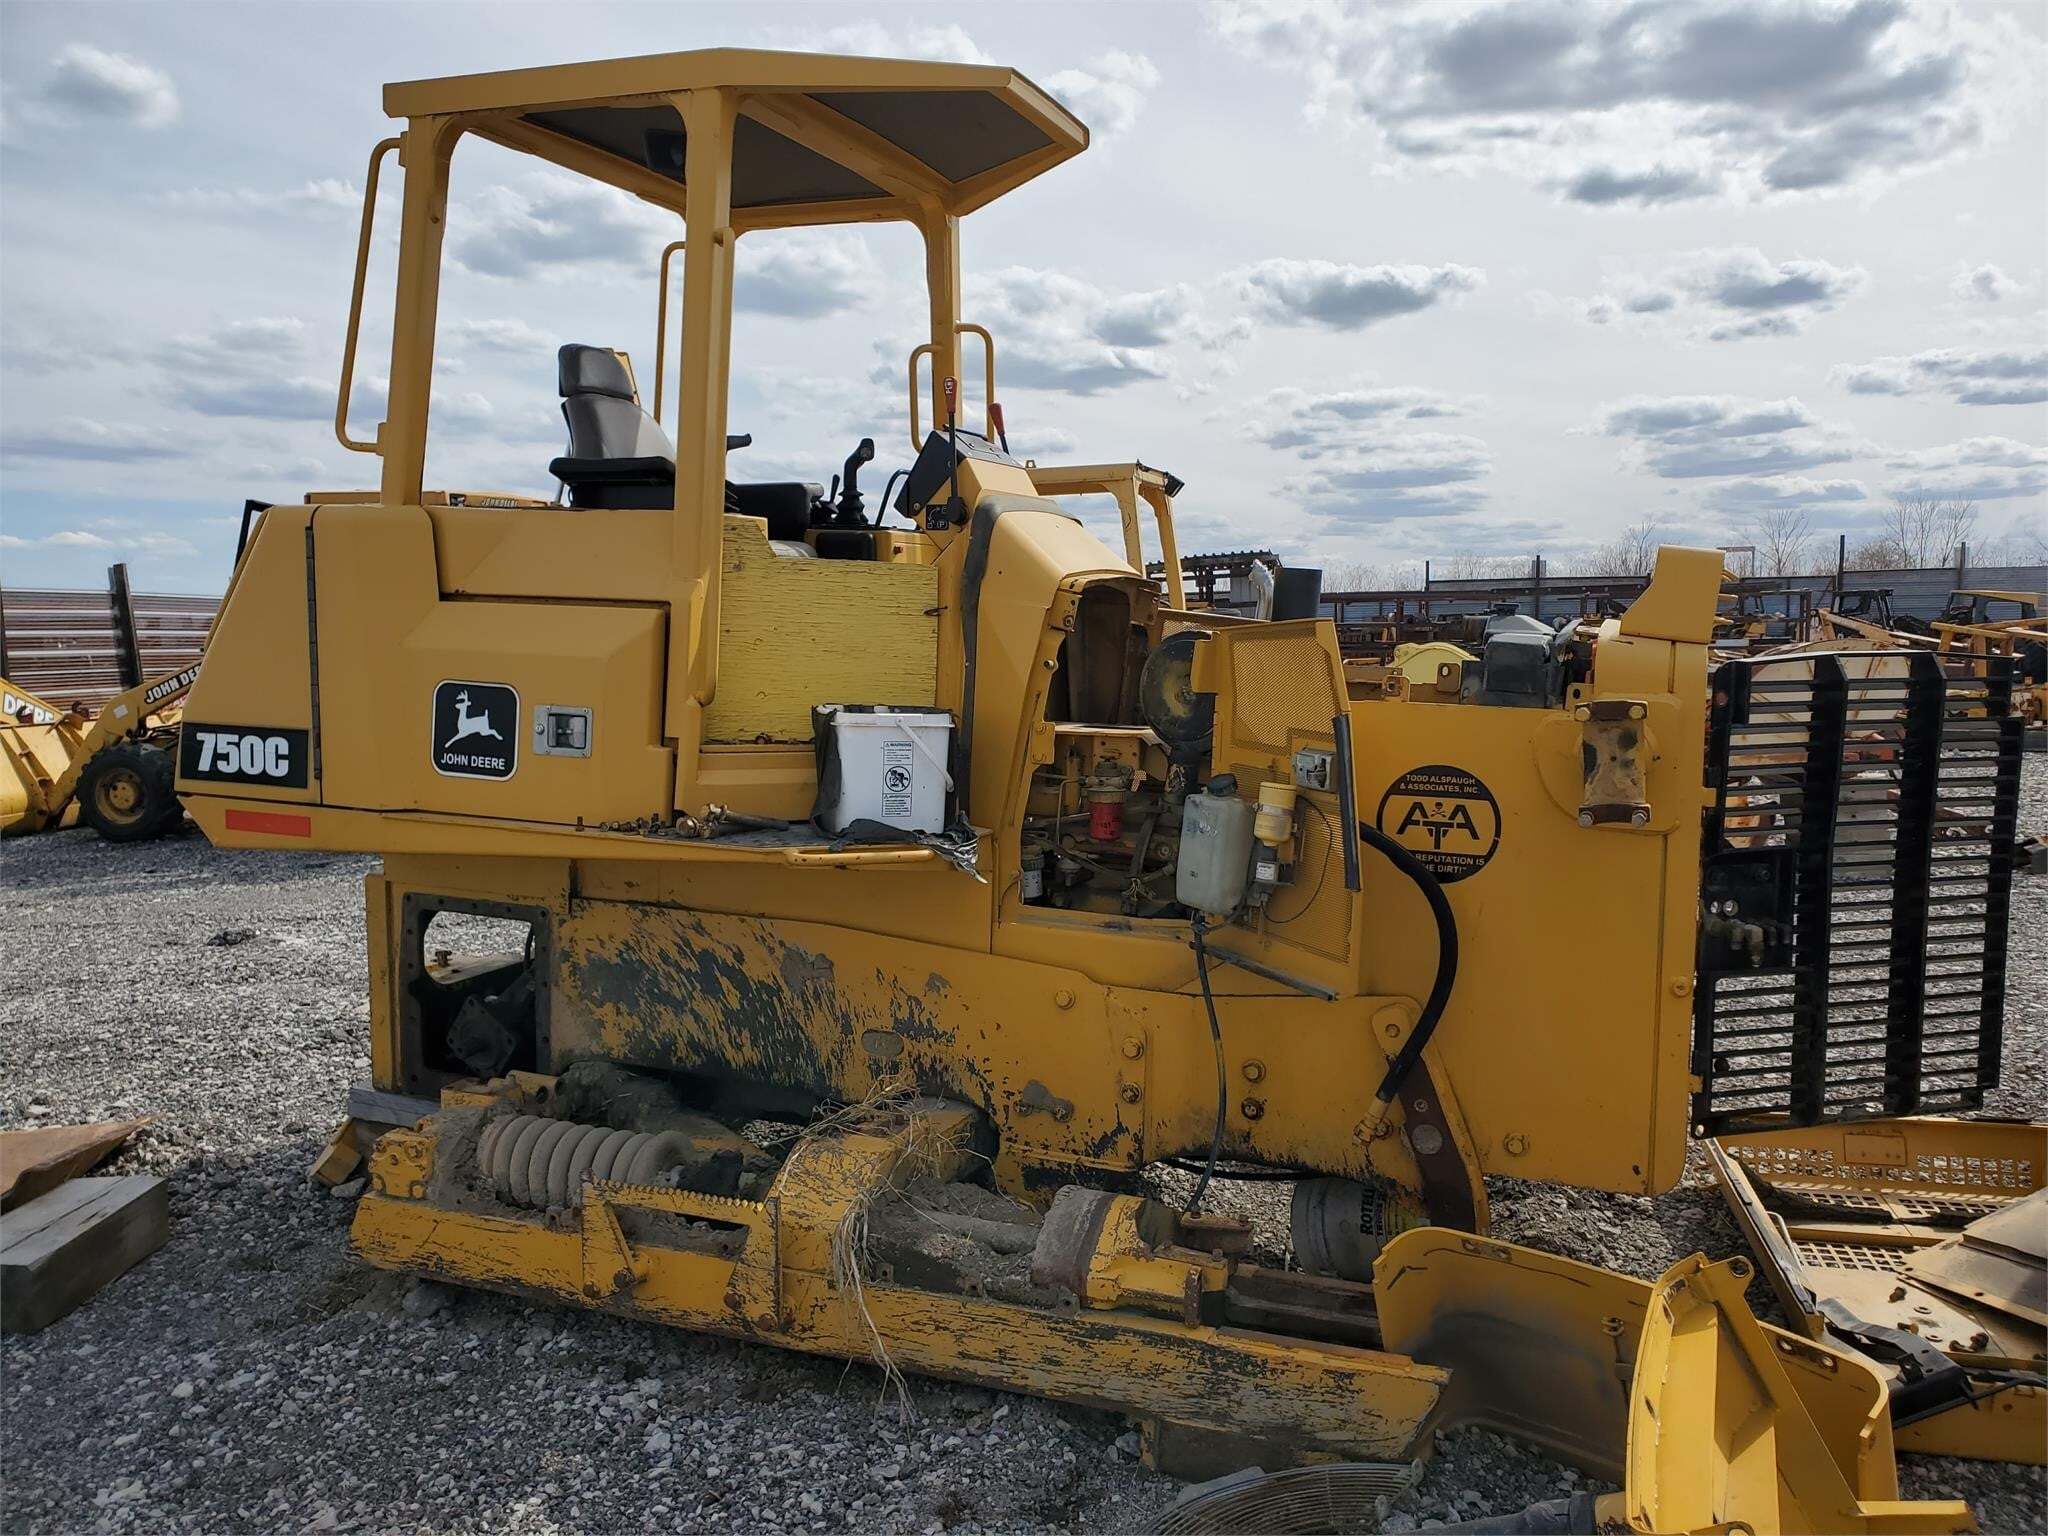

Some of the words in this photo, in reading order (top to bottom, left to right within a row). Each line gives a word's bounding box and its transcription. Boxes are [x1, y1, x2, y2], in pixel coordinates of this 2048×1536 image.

[146, 677, 180, 703] JOHN
[196, 732, 289, 778] 750C
[440, 752, 469, 767] JOHN
[470, 756, 506, 770] DEERE
[1406, 774, 1429, 782] TODD
[1430, 775, 1476, 785] ALSPAUGH
[1463, 786, 1481, 794] INC.
[1415, 853, 1474, 865] REPUTATION
[1475, 858, 1485, 866] IS
